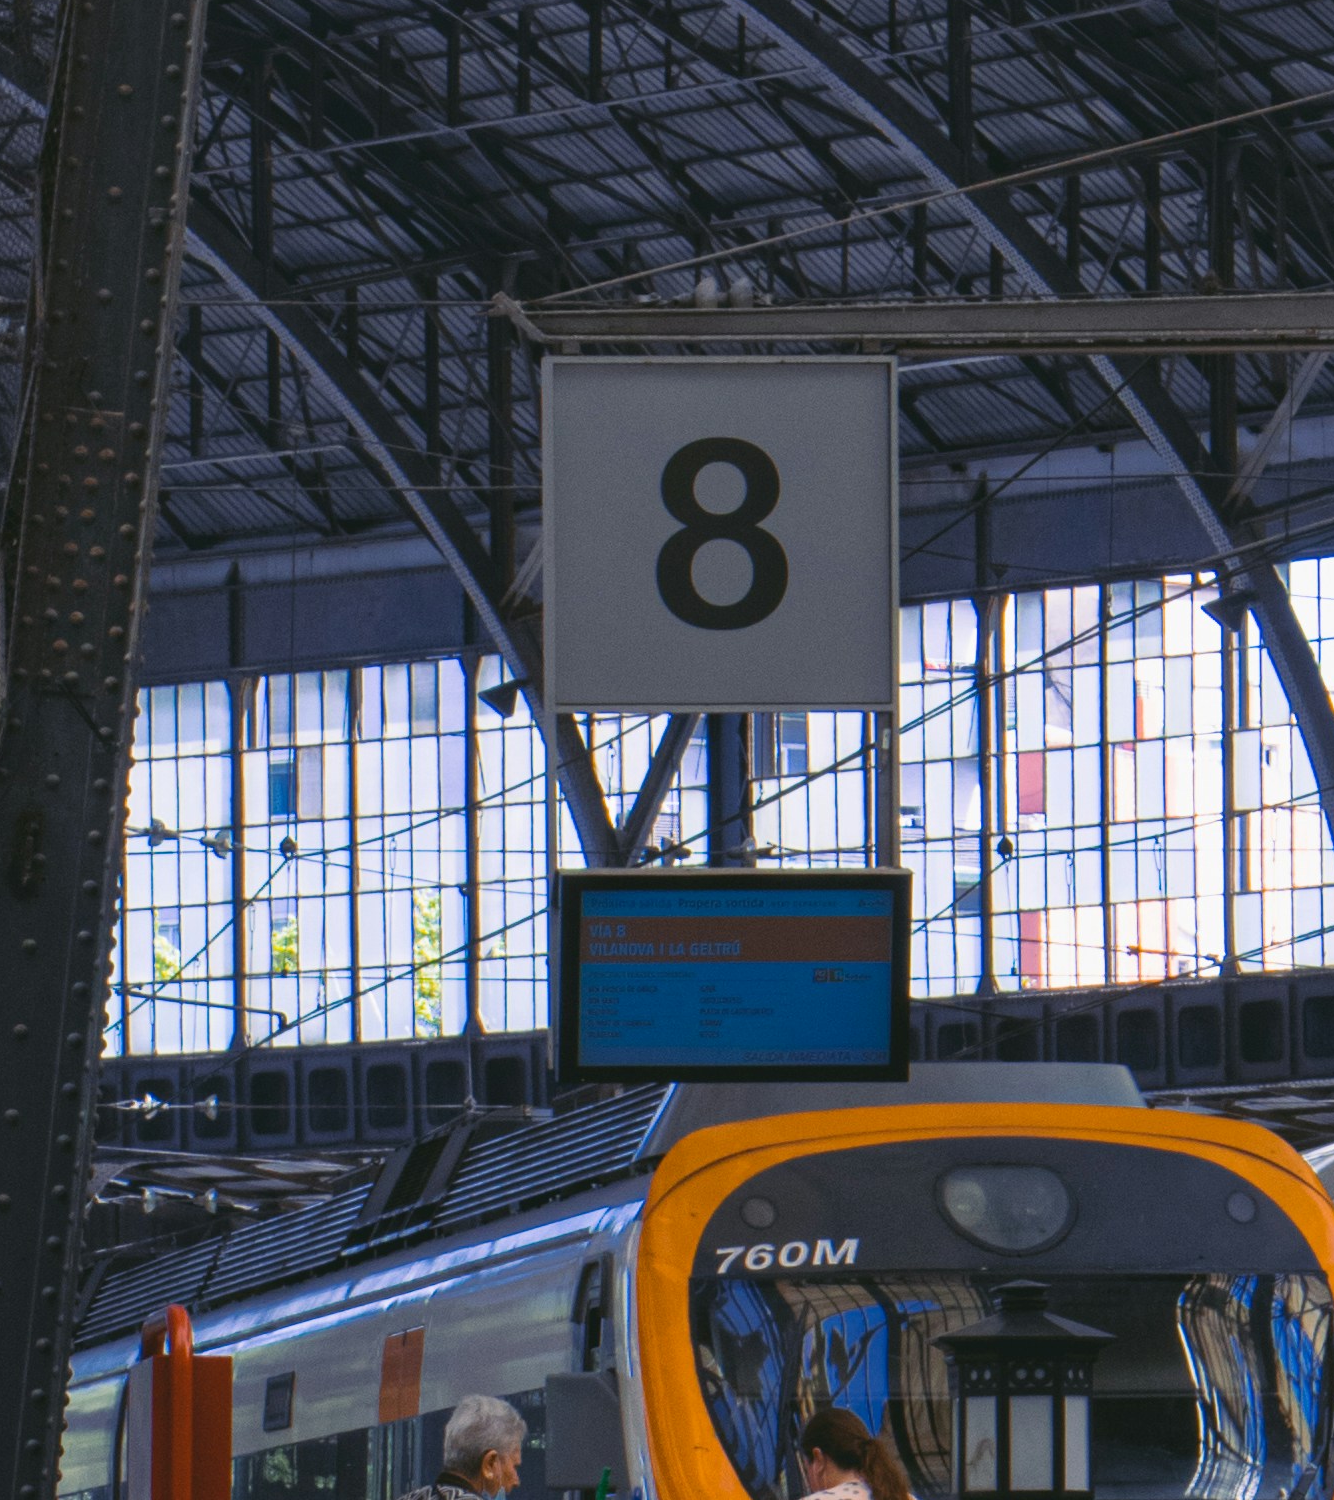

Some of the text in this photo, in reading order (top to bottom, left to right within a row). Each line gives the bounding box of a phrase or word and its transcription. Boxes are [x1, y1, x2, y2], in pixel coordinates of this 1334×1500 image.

[656, 436, 789, 631] 8
[678, 898, 722, 911] Propera
[725, 898, 764, 909] sortida
[589, 943, 655, 956] VILANOVA
[668, 943, 686, 956] LA
[689, 939, 741, 956] GELTRÚ
[715, 1237, 860, 1275] 760M
